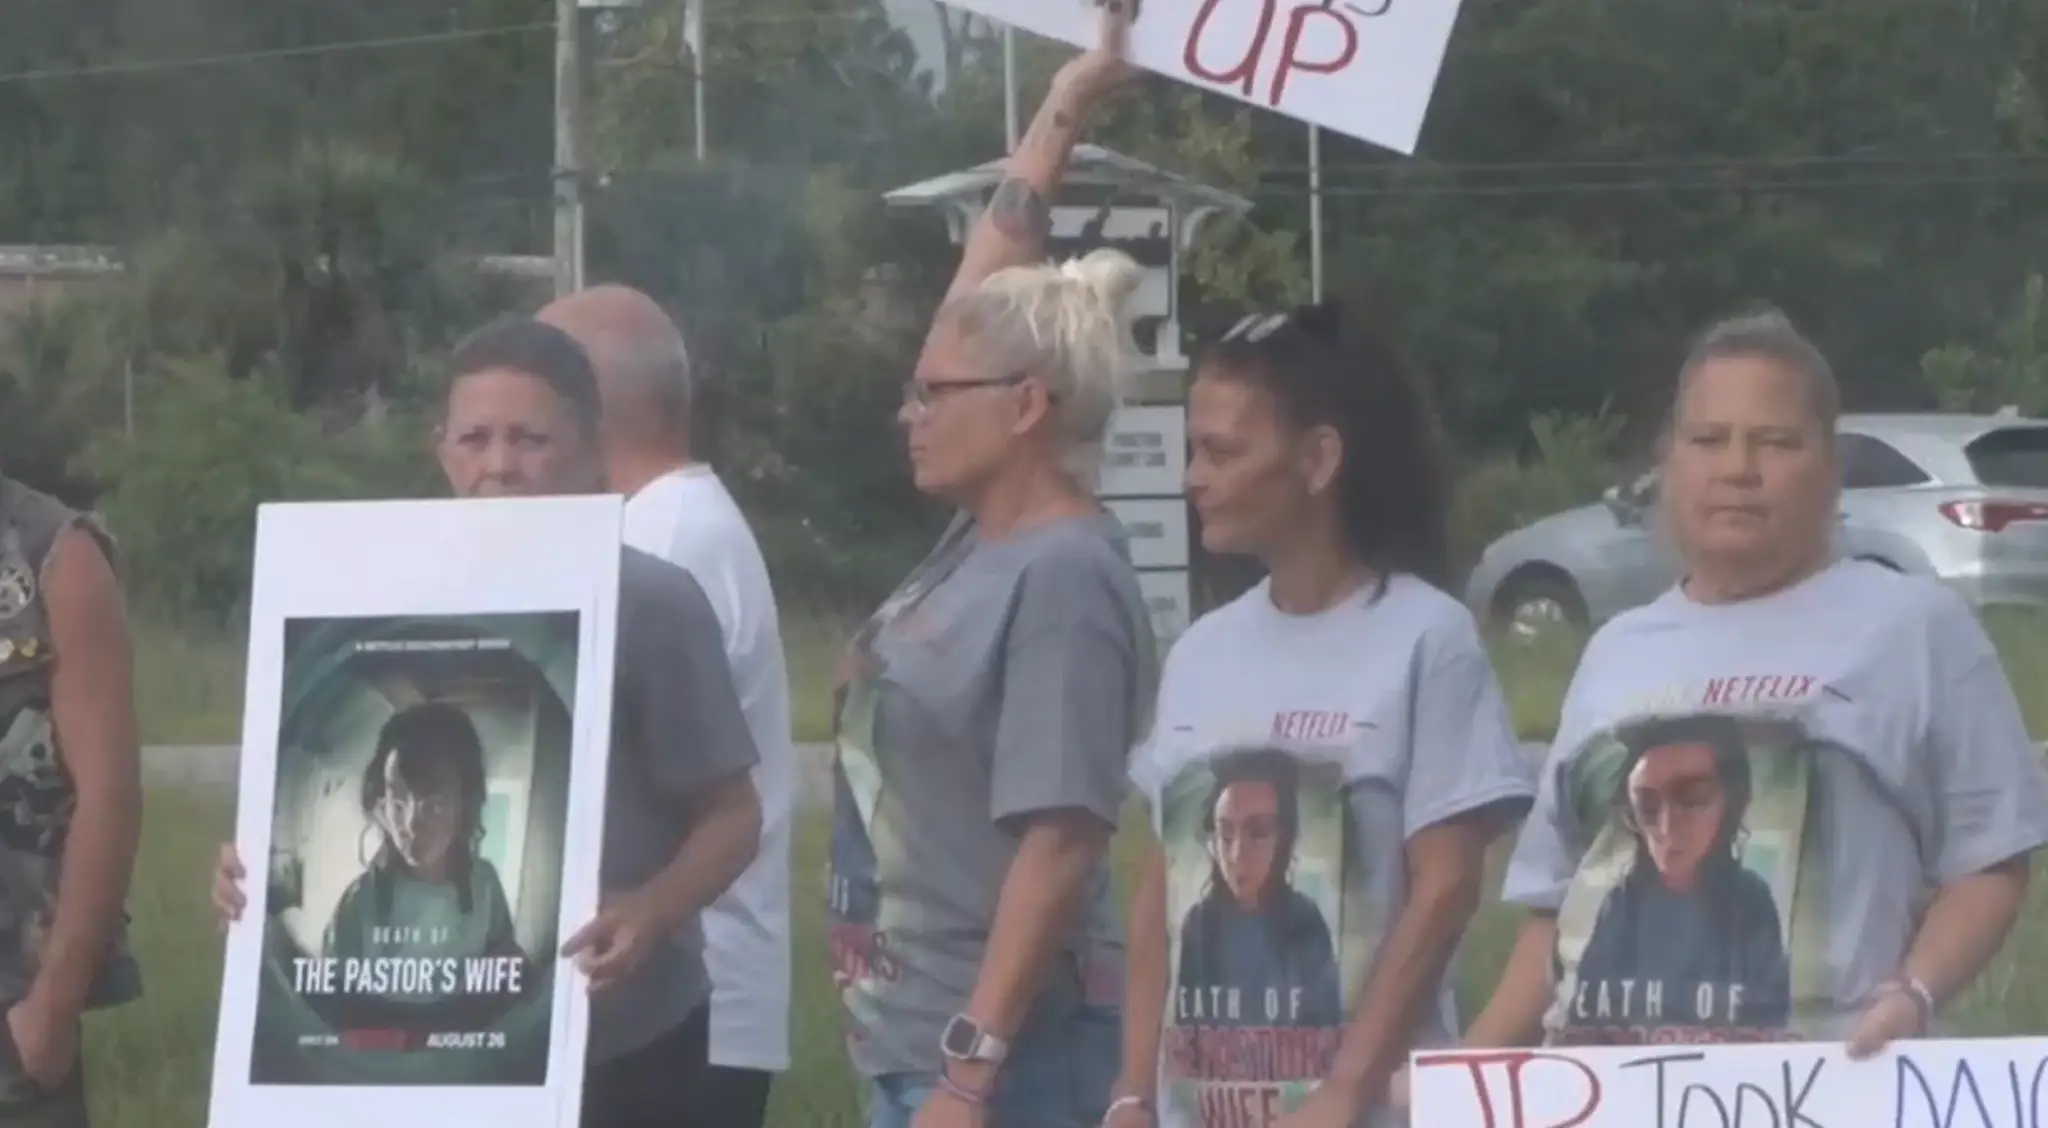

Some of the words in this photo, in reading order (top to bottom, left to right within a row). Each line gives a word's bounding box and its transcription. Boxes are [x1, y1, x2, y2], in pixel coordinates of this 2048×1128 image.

[1704, 675, 1816, 704] NETFLIX
[1271, 710, 1350, 739] NETFLIX
[293, 957, 338, 993] THE
[343, 957, 457, 993] PASTOR'S
[464, 957, 524, 993] WIFE
[1264, 987, 1303, 1020] OF
[1696, 983, 1745, 1023] OF
